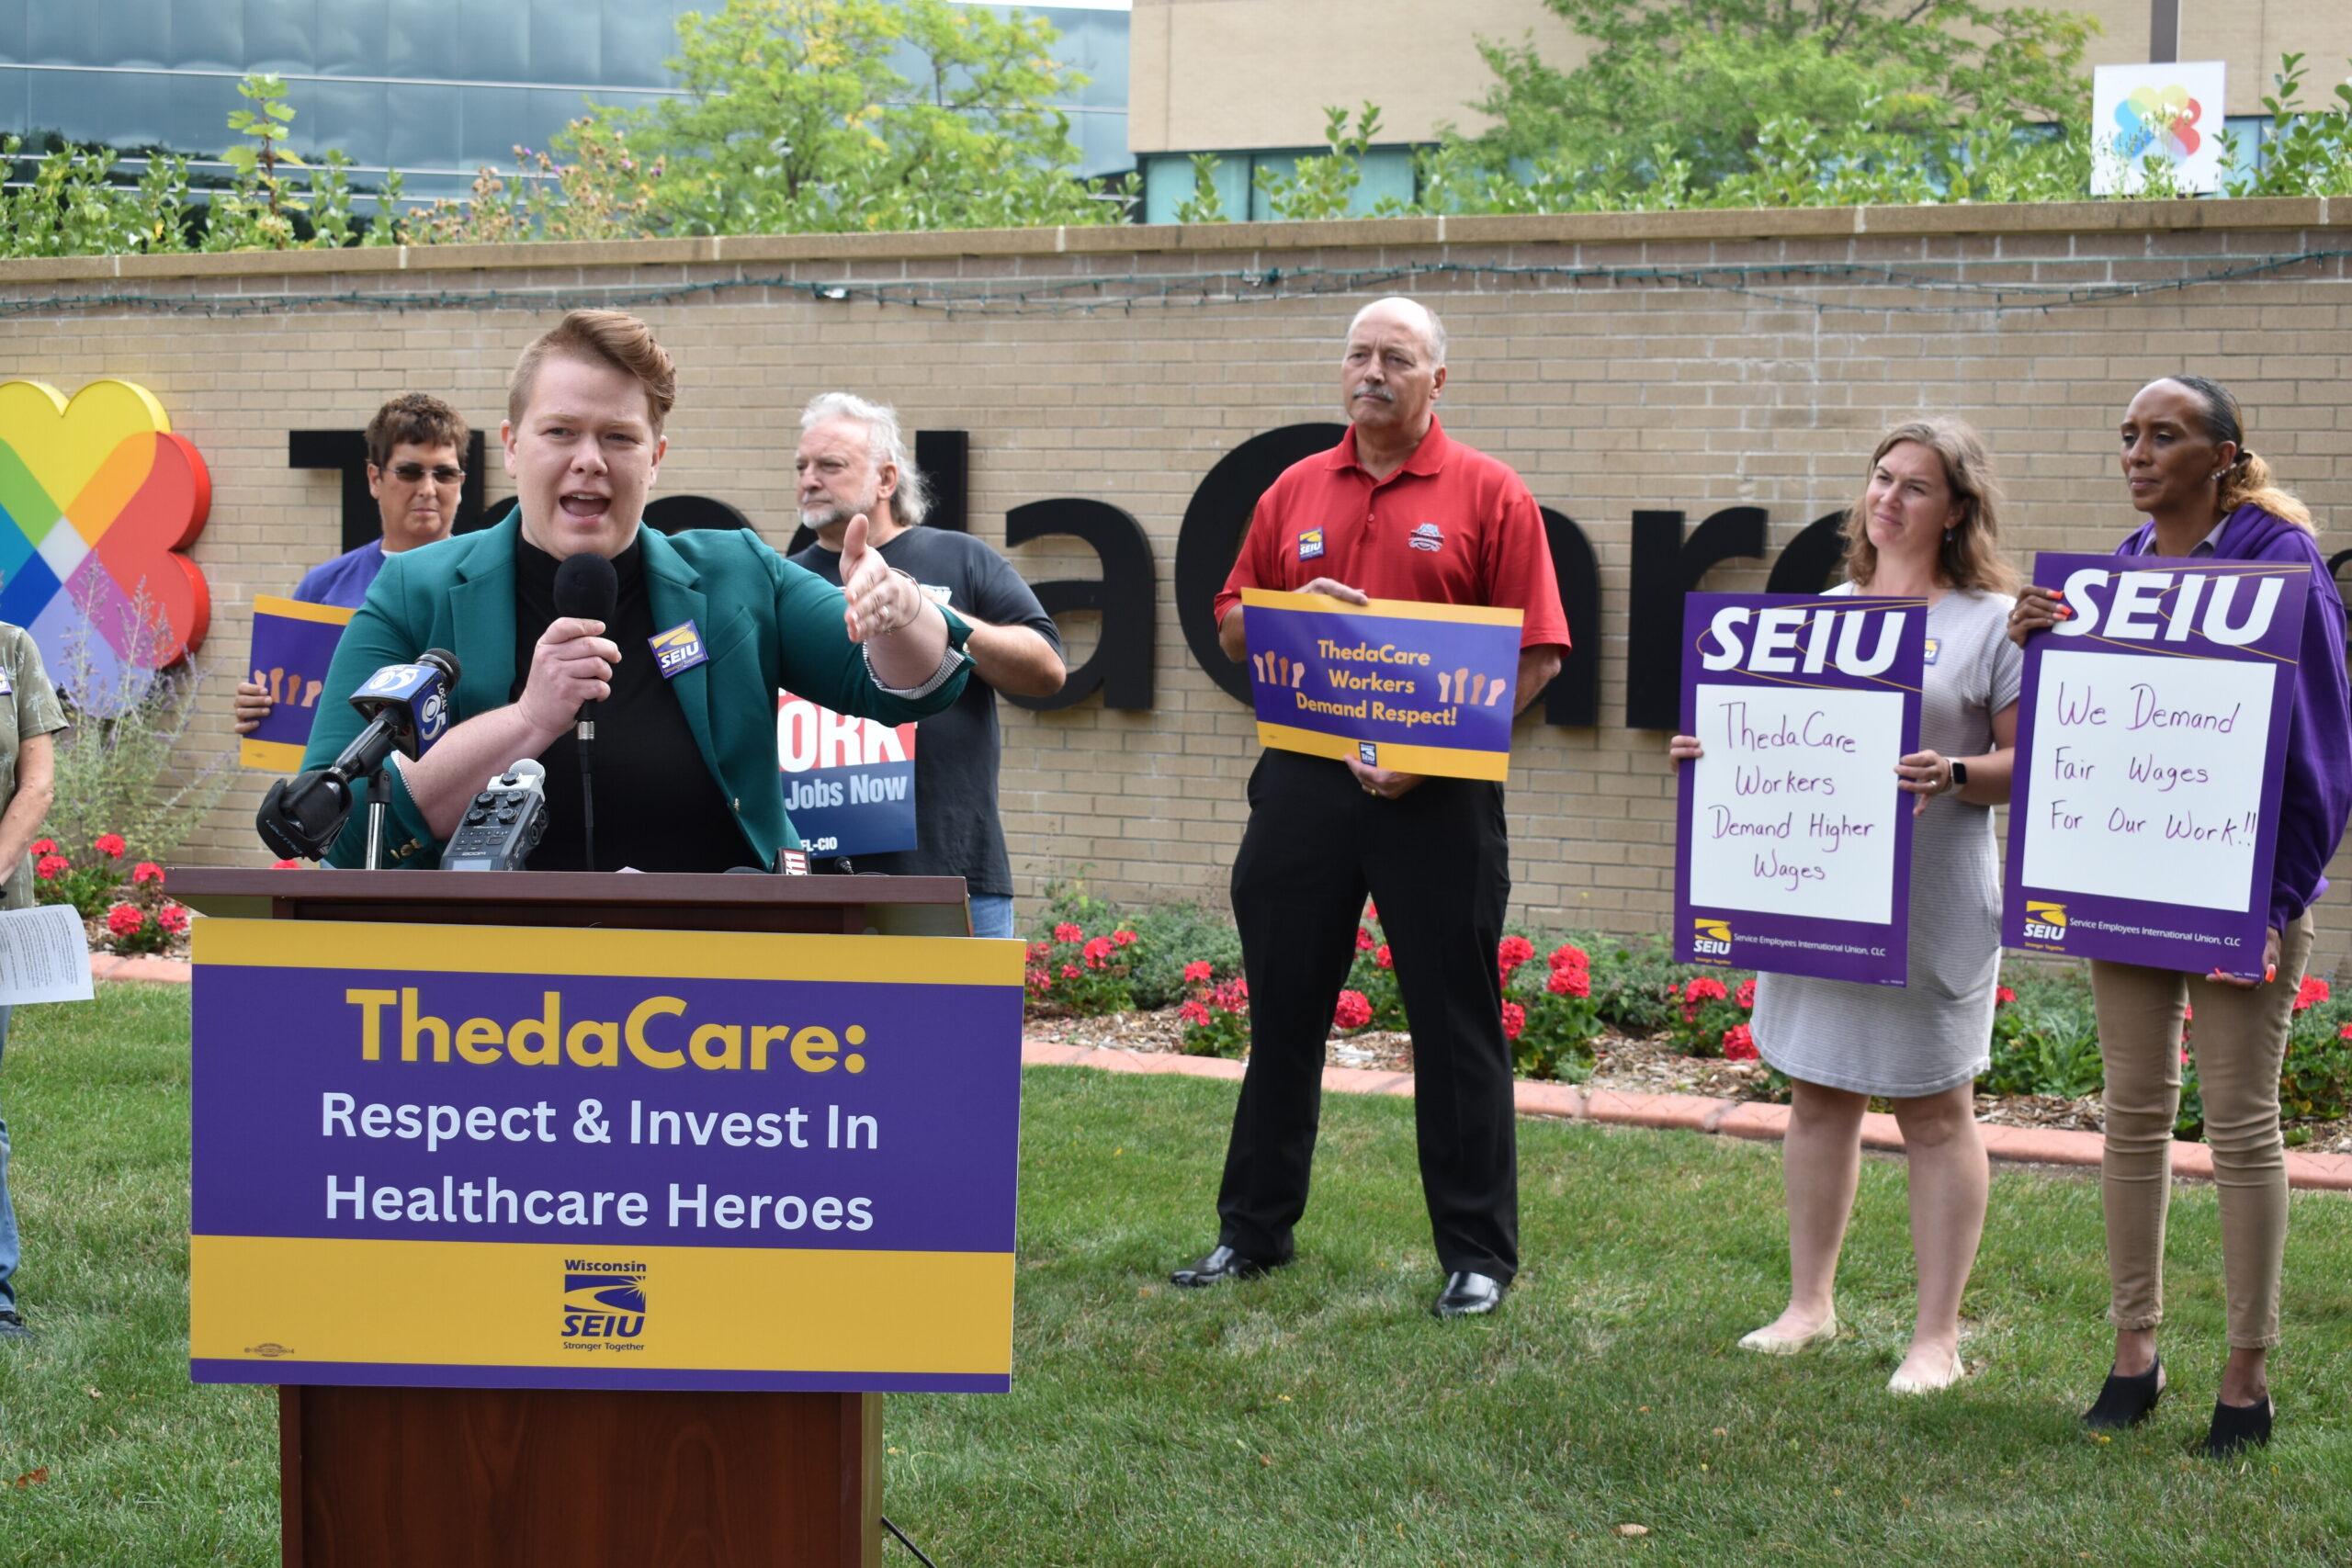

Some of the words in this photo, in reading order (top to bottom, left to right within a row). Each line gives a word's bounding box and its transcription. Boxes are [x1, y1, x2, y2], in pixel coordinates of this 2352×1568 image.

[1299, 542, 1322, 555] SEIU
[2051, 568, 2285, 646] SEIU
[661, 641, 699, 669] SEIU
[1317, 639, 1430, 666] ThedaCare
[1702, 606, 1906, 677] SEIU
[436, 682, 449, 711] LOCAL
[1329, 669, 1416, 694] Workers
[1295, 691, 1367, 719] Demand
[1372, 701, 1458, 728] Respect!
[2058, 682, 2107, 726] We
[2125, 682, 2241, 734] Demand
[777, 700, 908, 773] ORK
[1735, 764, 1836, 796] Workers
[2054, 746, 2096, 781] Fair
[2128, 753, 2210, 793] Wages
[785, 778, 844, 811] Jobs
[850, 773, 908, 805] Now
[1707, 804, 1792, 840] Demand
[1808, 812, 1876, 853] Higher
[2051, 799, 2084, 830] For
[2108, 807, 2147, 834] Our
[2165, 809, 2257, 848] Work!!
[801, 836, 838, 852] FL-CIO
[1753, 848, 1826, 892] Wages
[1693, 939, 1731, 955] SEIU
[1734, 932, 1758, 943] Service
[1759, 935, 1797, 948] Employees
[1798, 940, 1844, 953] International
[1844, 945, 1869, 955] Union,
[1871, 947, 1886, 957] CLC
[2023, 923, 2066, 941] SEIU
[2069, 918, 2097, 930] Service
[2098, 921, 2141, 935] Employees
[2142, 926, 2193, 942] International
[2194, 933, 2222, 945] Union,
[2223, 936, 2241, 947] CLC
[345, 987, 866, 1074] ThedaCare:
[322, 1092, 557, 1152] Respect
[572, 1098, 611, 1144] &
[630, 1100, 808, 1148] Invest
[827, 1104, 878, 1149] In
[326, 1175, 649, 1226] Healthcare
[668, 1183, 874, 1232] Heroes
[564, 1259, 647, 1272] Wisconsin
[560, 1314, 645, 1337] SEIU
[563, 1341, 602, 1352] Stronger
[605, 1342, 645, 1353] Together
